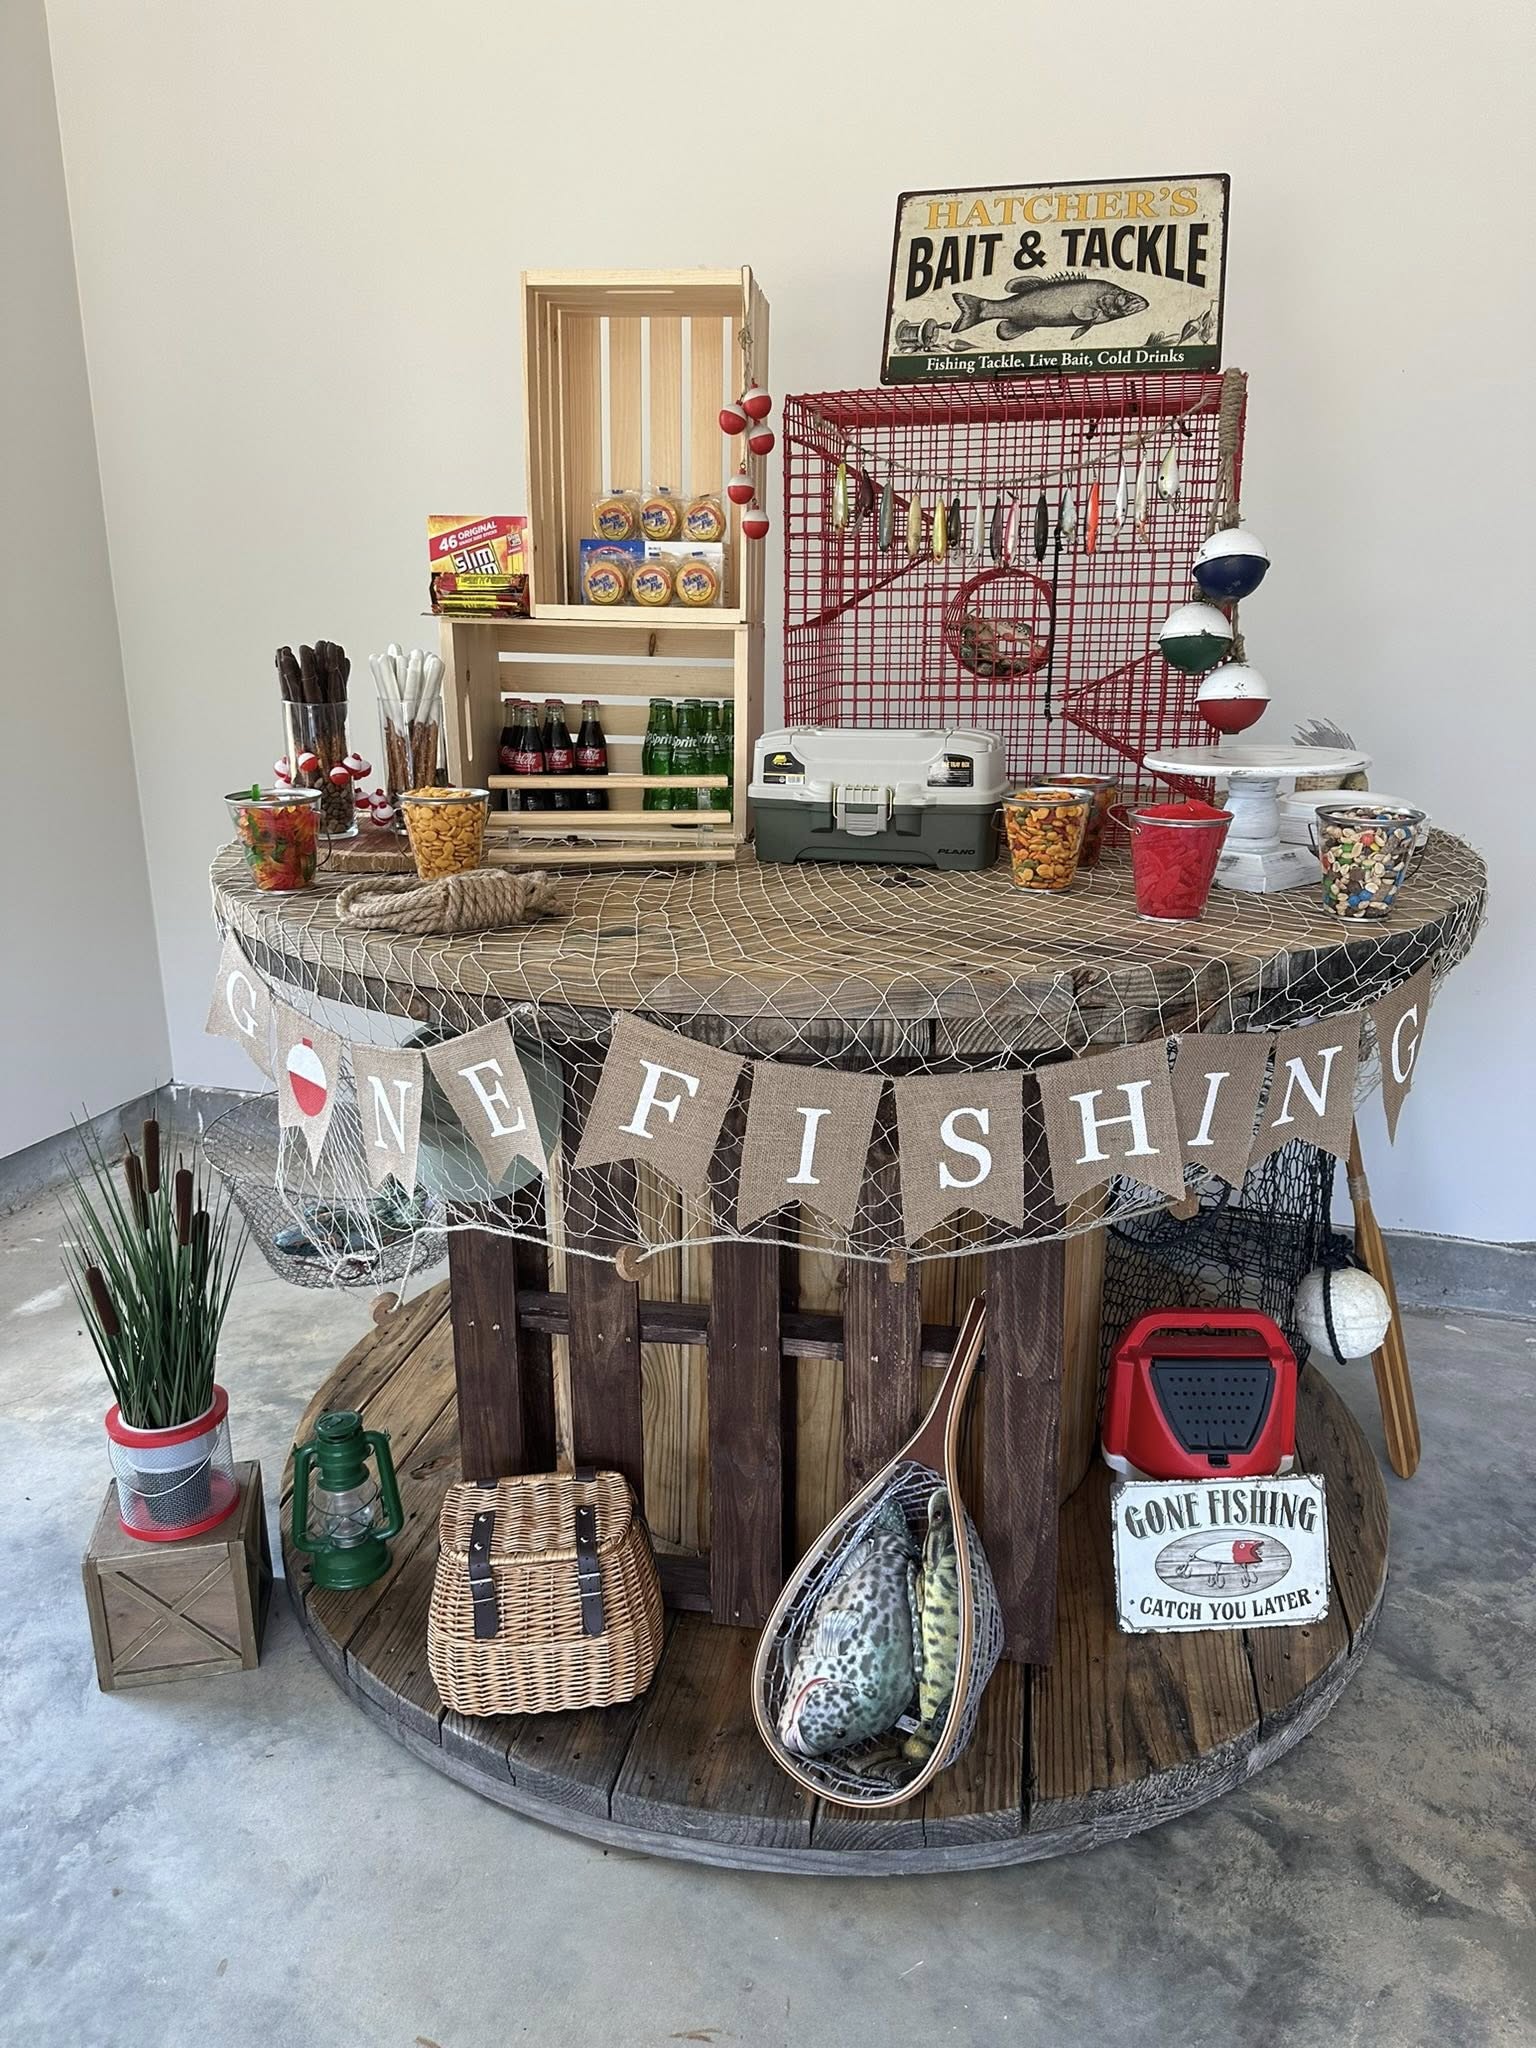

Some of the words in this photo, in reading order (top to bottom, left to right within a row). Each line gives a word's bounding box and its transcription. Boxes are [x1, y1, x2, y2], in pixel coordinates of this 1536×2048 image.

[924, 186, 1199, 230] HATCHER'S
[905, 232, 1003, 302] BAIT
[1013, 230, 1047, 271] &
[1060, 222, 1209, 289] TACKLE
[926, 357, 976, 374] Fishing
[1029, 353, 1058, 368] Live
[1061, 352, 1094, 367] Bait,
[1097, 351, 1132, 365] Cold
[1136, 349, 1185, 364] Drinks
[439, 534, 458, 551] 46
[457, 521, 497, 540] ORIGINAL
[651, 733, 672, 746] Sprit
[1125, 1492, 1201, 1539] GONE
[1207, 1489, 1318, 1533] FISHING
[1140, 1596, 1202, 1621] CATCH
[1208, 1601, 1247, 1621] YOU
[1253, 1588, 1312, 1617] LATER
